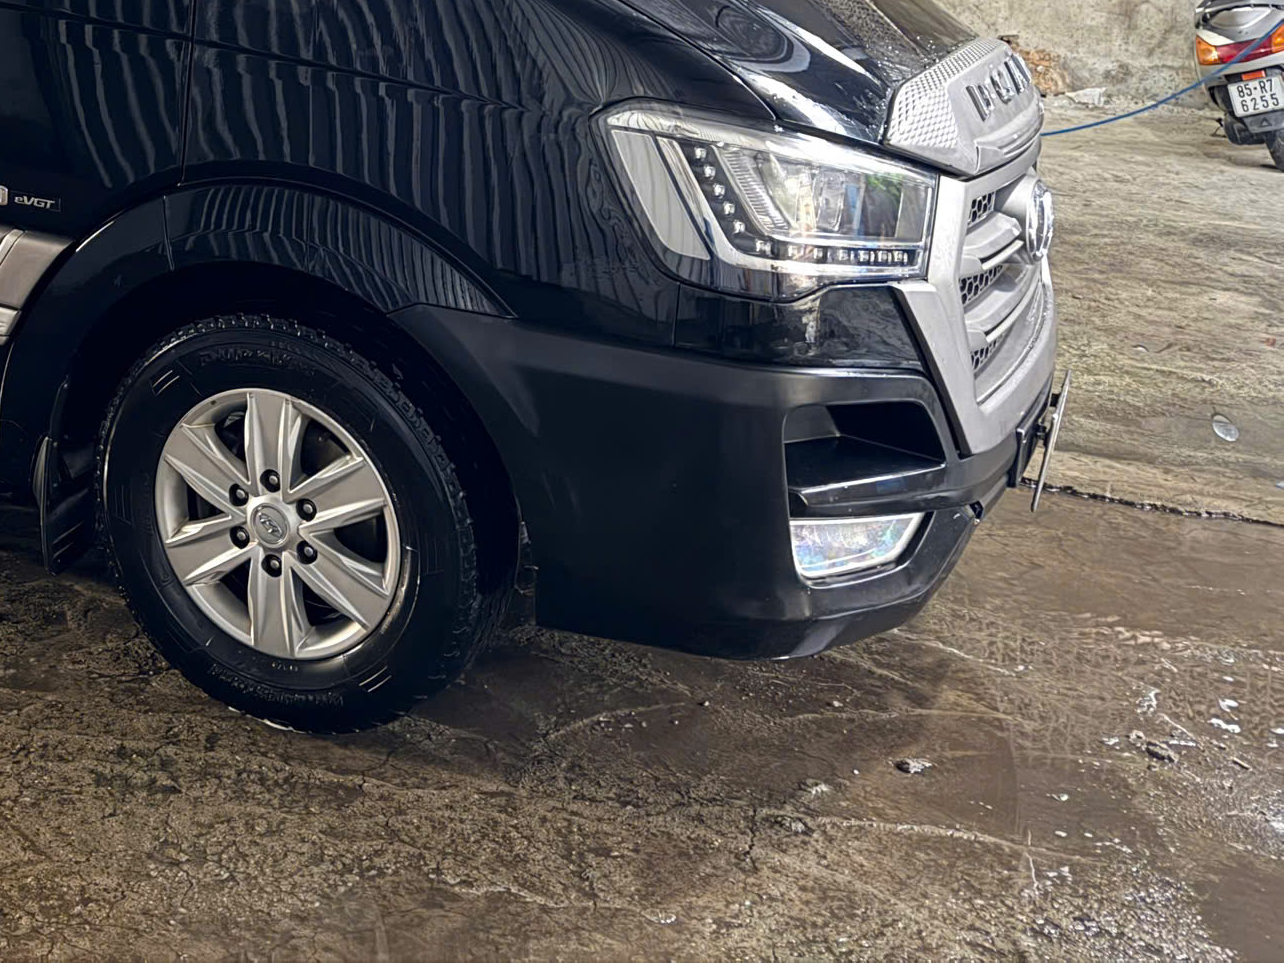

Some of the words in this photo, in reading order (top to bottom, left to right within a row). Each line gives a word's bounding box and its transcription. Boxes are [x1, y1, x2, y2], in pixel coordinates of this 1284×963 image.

[1236, 78, 1273, 98] 85-R7
[1240, 93, 1280, 112] 6255
[14, 195, 55, 209] eVGT
